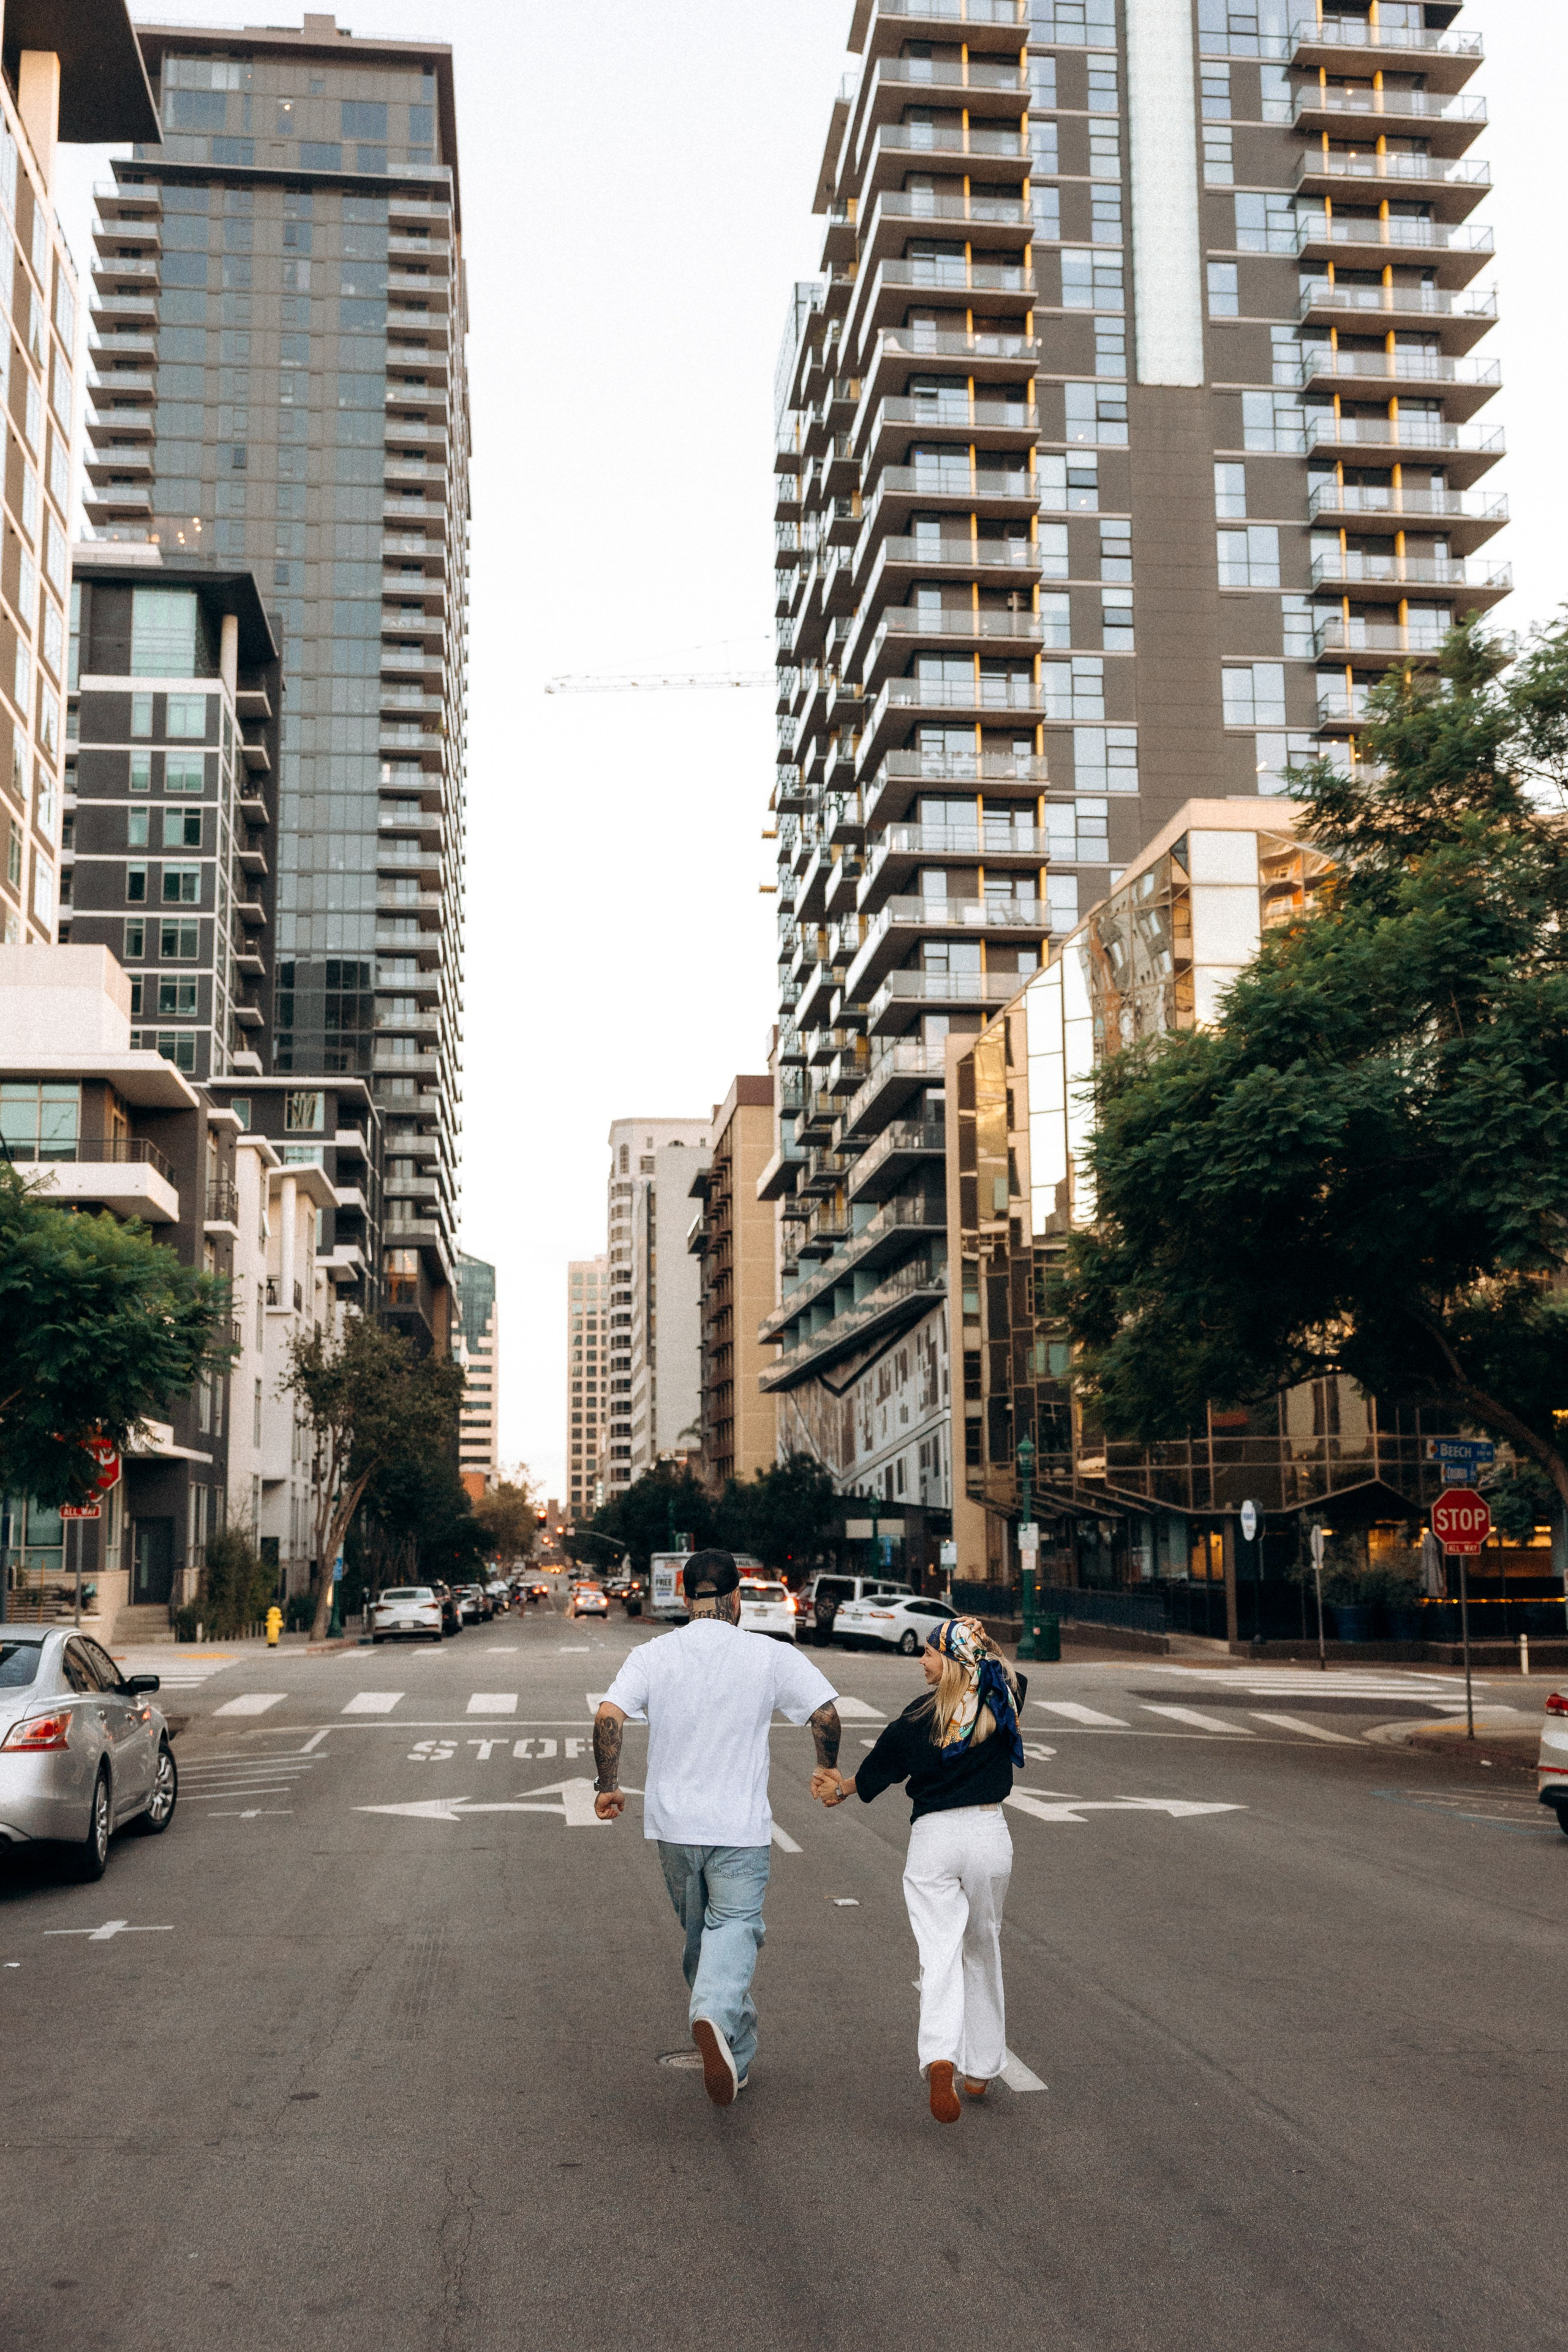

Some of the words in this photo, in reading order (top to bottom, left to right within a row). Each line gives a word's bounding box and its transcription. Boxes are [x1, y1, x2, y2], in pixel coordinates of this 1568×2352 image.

[1440, 1443, 1471, 1457] BEECH
[63, 1507, 77, 1516] ALL
[1436, 1508, 1486, 1531] STOP
